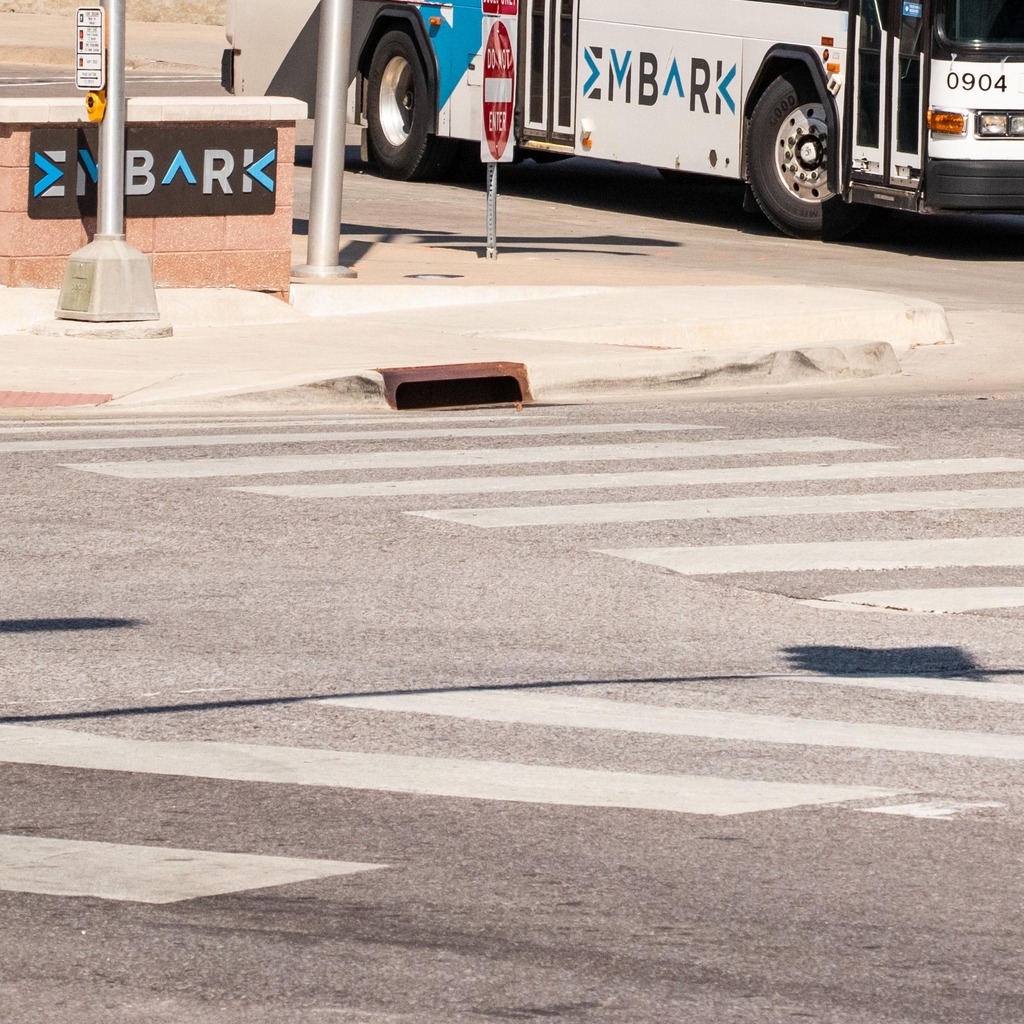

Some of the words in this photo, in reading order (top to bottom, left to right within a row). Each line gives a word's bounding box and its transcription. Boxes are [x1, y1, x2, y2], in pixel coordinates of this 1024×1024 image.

[487, 48, 496, 70] DO
[583, 46, 737, 116] EMBARK
[947, 71, 1007, 93] 0904
[488, 111, 507, 132] ENTER
